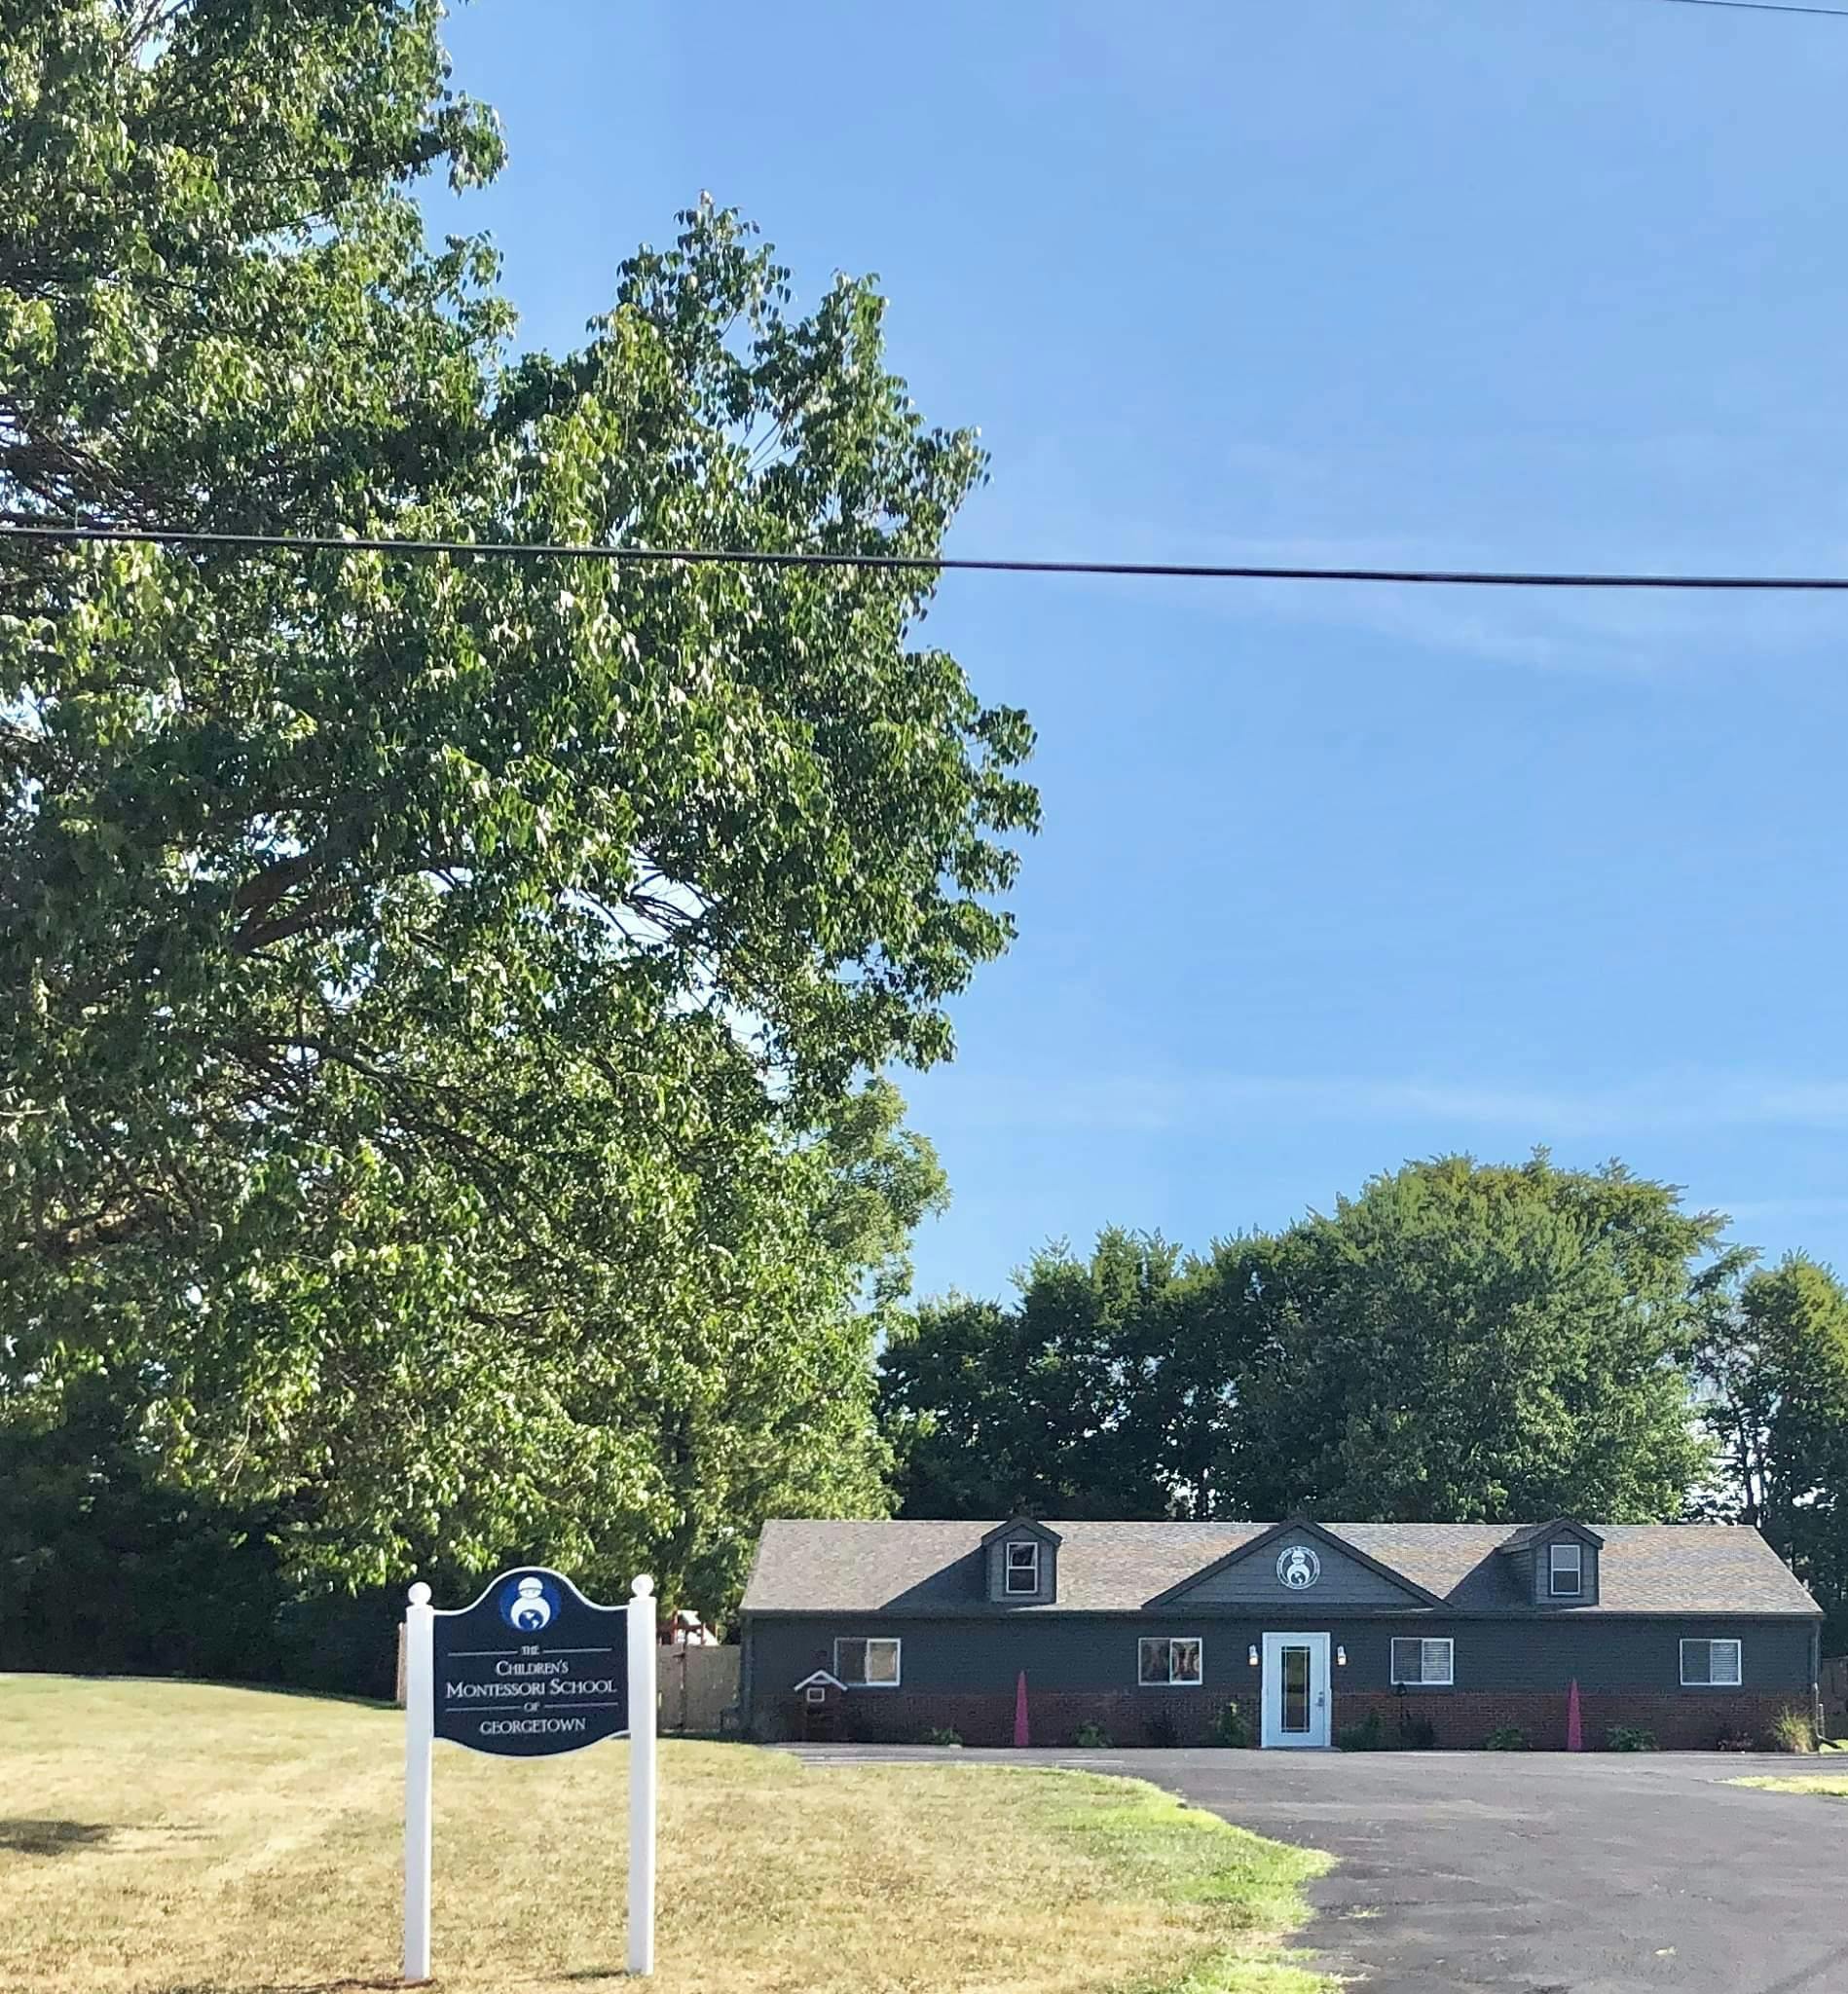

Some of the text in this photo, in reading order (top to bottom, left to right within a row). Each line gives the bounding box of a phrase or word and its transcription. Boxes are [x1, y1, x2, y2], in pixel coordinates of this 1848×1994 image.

[521, 1645, 540, 1655] THE
[497, 1660, 569, 1676] CHILDREN'S
[447, 1679, 616, 1698] MONTESSORI SCHOOL
[524, 1702, 540, 1712] OF
[480, 1717, 586, 1734] GEORGETOWN
